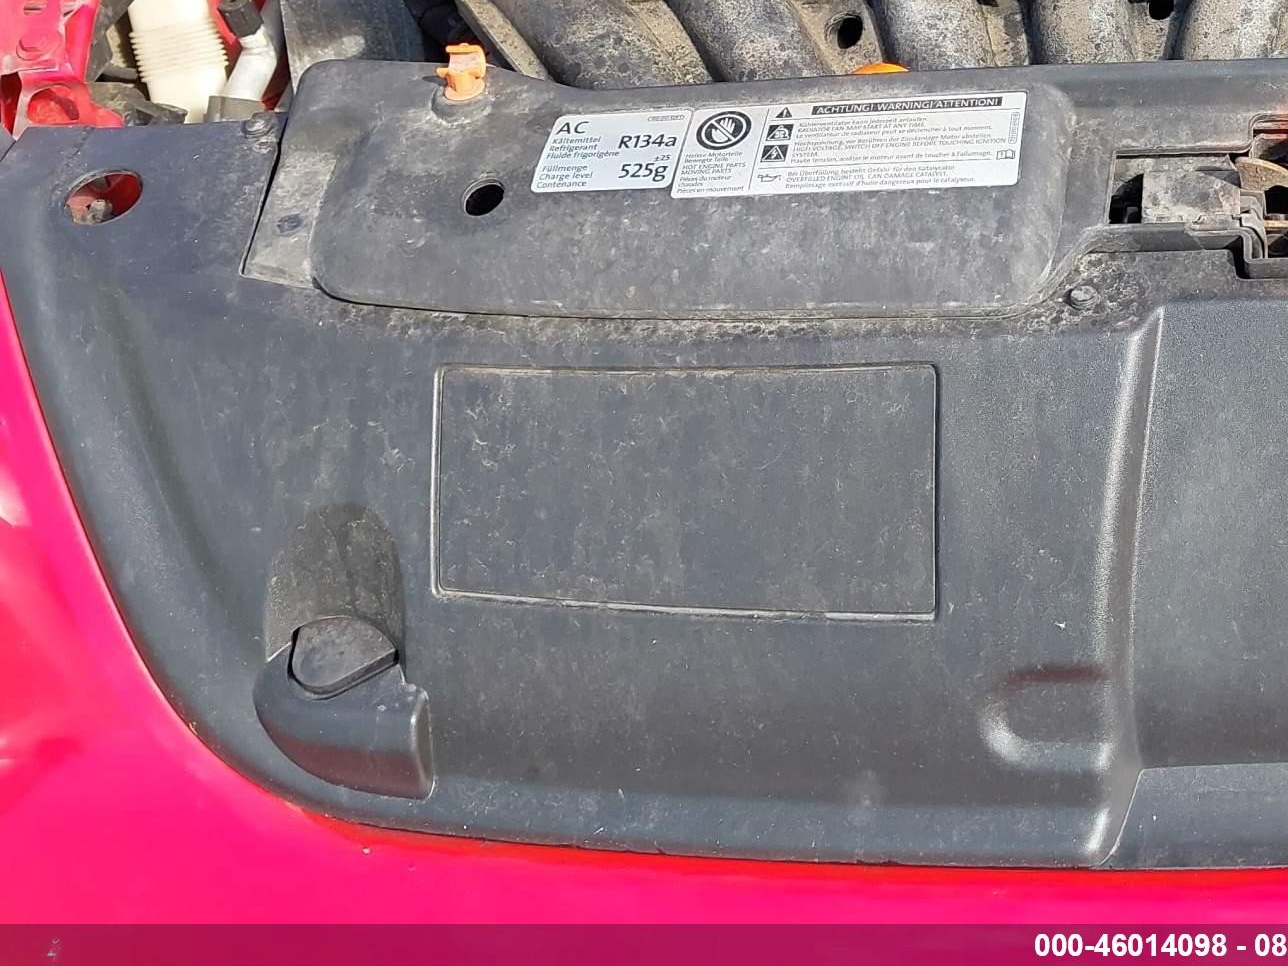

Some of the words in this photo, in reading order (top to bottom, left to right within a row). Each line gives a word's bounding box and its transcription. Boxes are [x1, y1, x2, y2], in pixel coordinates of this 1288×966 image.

[816, 104, 873, 114] ACHTUNG!
[876, 100, 934, 112] WARNING!
[935, 98, 1000, 108] ATTENTION!
[556, 121, 590, 134] AC
[552, 136, 602, 144] Kältemittel
[618, 134, 678, 149] R134a
[549, 144, 598, 153] Refrigerant
[546, 152, 572, 160] Fluide
[573, 150, 620, 160] frigorigène
[655, 154, 672, 162] ±25
[542, 164, 588, 173] Füllmenge
[618, 162, 668, 182] 525g
[540, 173, 570, 182] Charge
[572, 172, 593, 180] level
[536, 180, 588, 188] Contenance
